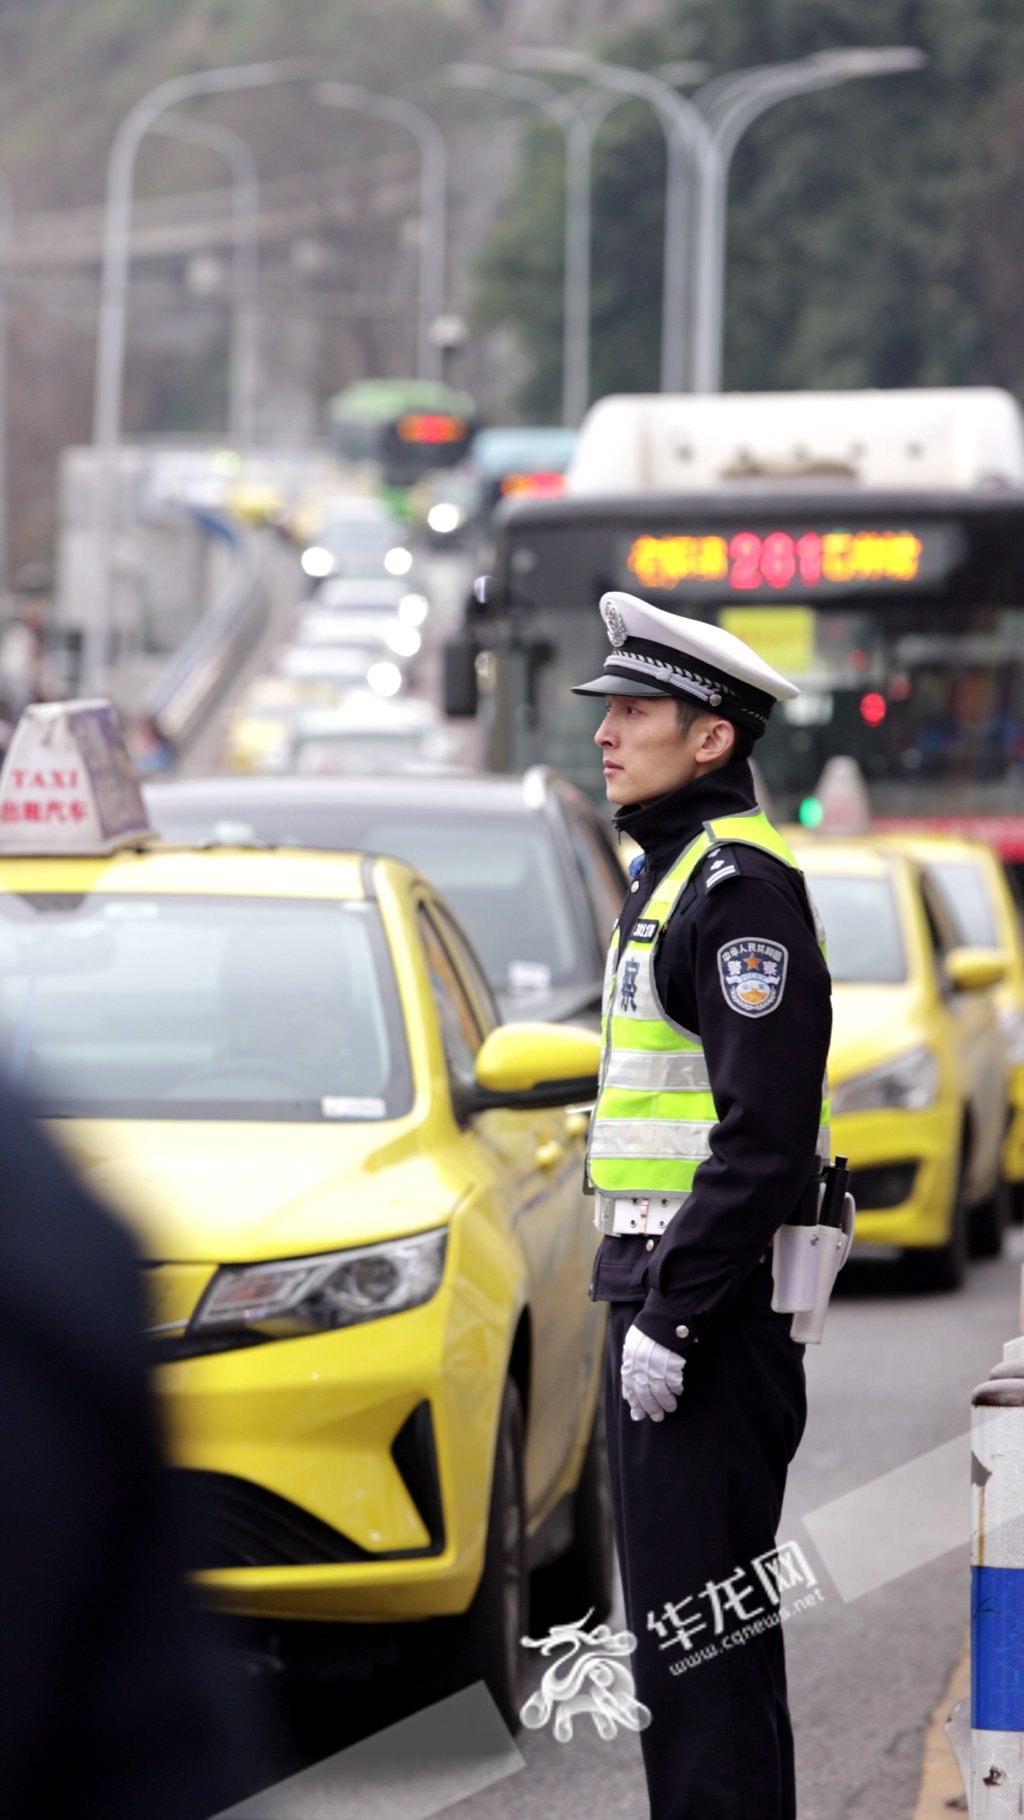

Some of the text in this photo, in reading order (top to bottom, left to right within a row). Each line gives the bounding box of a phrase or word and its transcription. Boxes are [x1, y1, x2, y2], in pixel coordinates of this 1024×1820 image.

[12, 769, 78, 788] TAXI
[721, 942, 783, 962] 中华人民共和国
